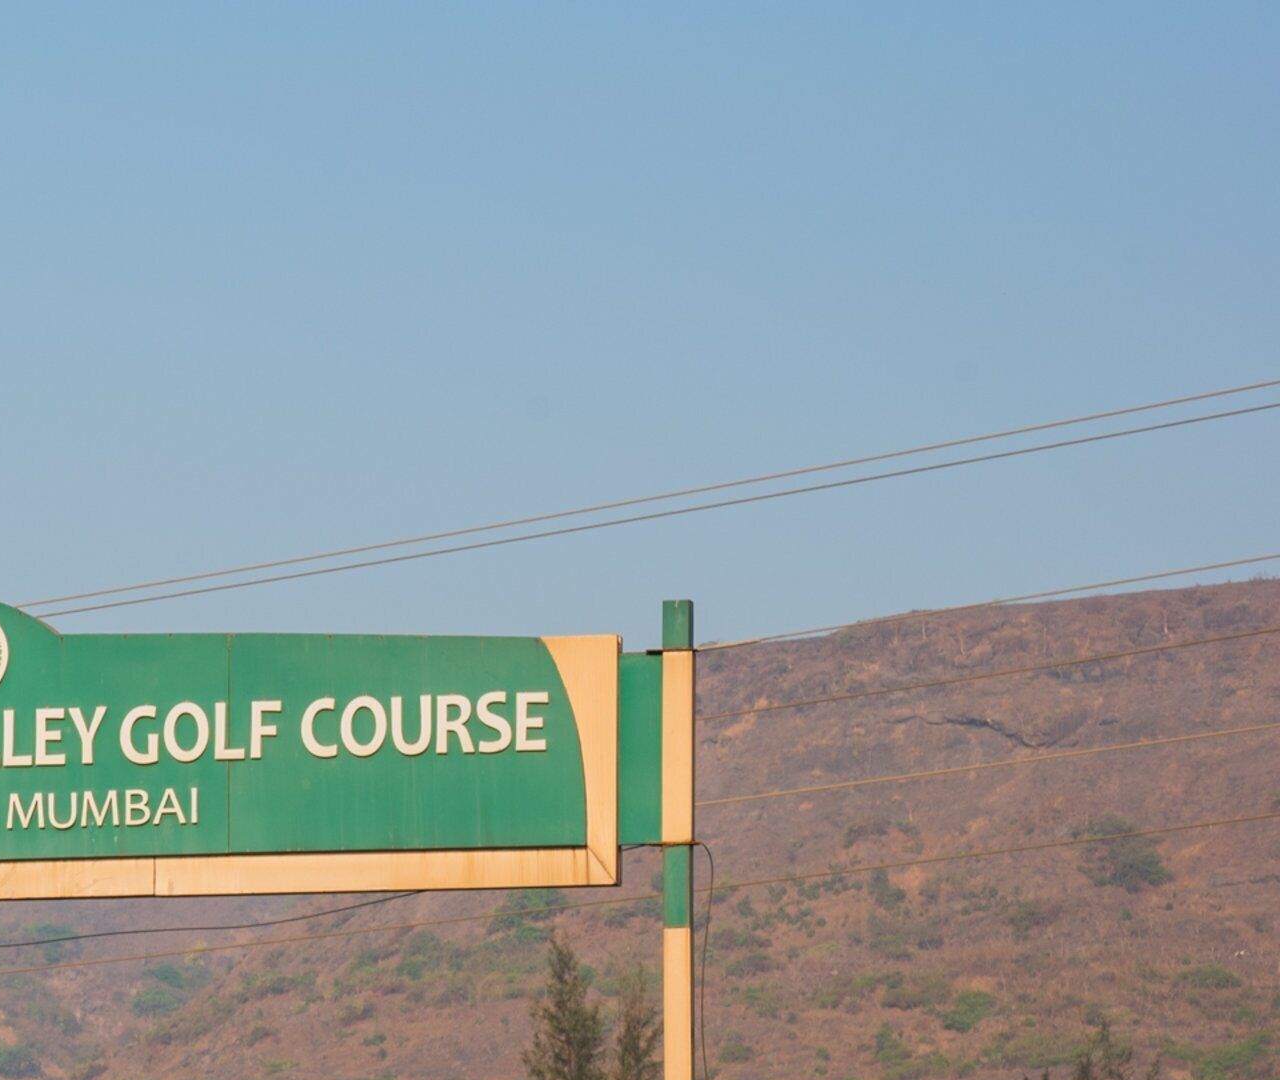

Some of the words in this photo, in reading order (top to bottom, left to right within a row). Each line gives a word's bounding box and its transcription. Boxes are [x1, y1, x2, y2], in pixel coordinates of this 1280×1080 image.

[119, 700, 283, 765] GOLF
[300, 691, 549, 758] COURSE
[6, 787, 199, 831] MUMBAI
